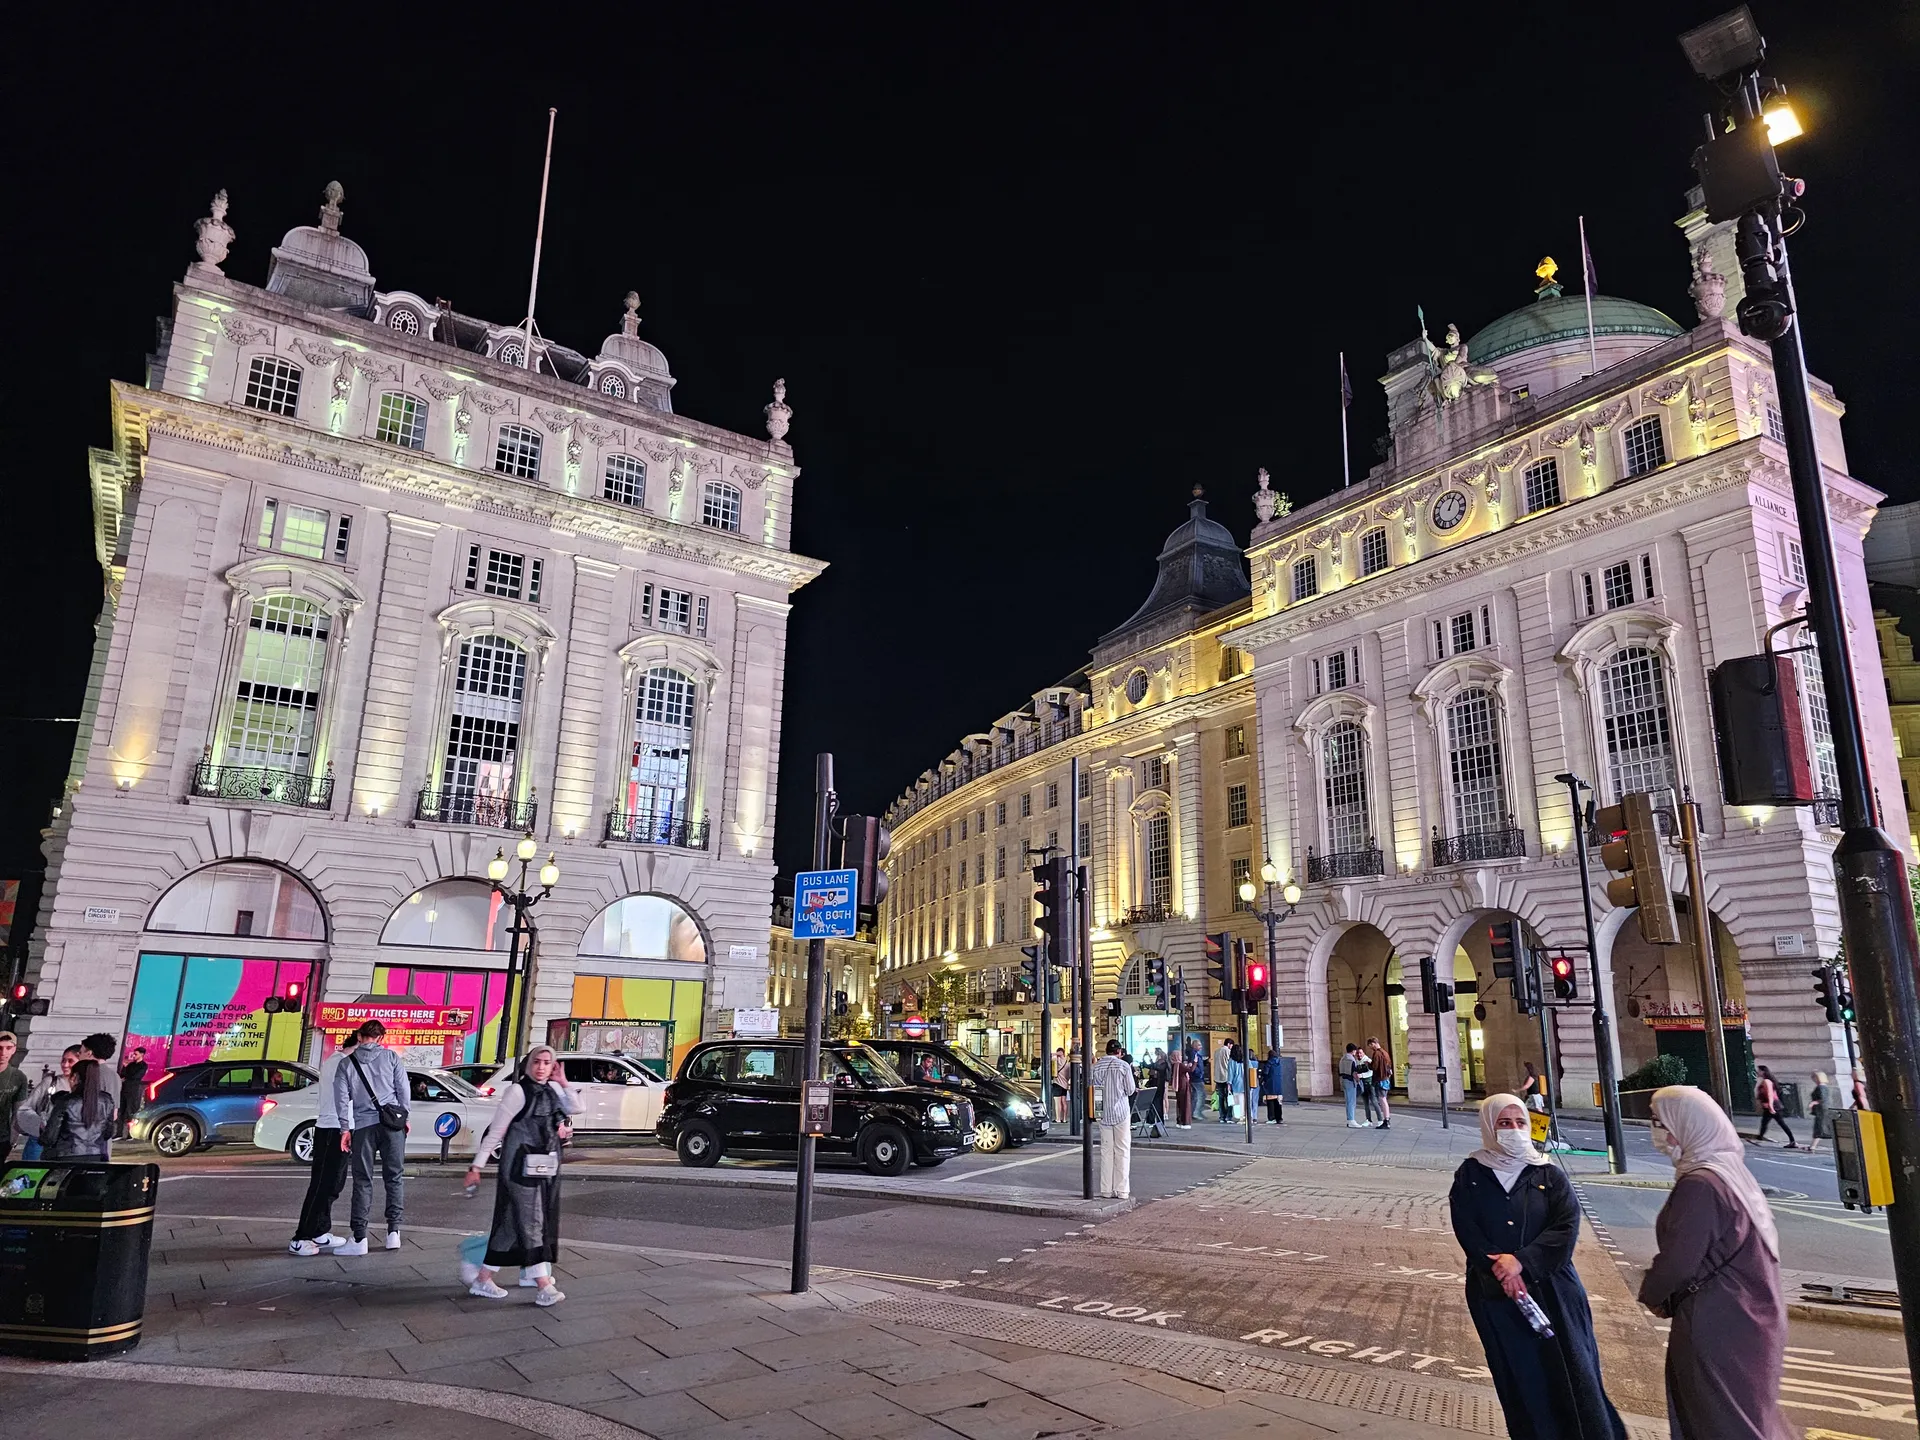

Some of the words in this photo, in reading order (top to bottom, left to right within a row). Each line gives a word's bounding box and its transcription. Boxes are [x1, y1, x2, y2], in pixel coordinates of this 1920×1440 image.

[1754, 495, 1788, 518] ALLIANCE
[803, 876, 822, 886] BUS
[825, 874, 850, 885] LANE
[1415, 872, 1463, 884] COUNTY
[797, 911, 824, 921] LOOK
[825, 910, 852, 920] BOTH
[810, 923, 837, 934] WAYS
[184, 1002, 220, 1011] FASTEN
[222, 1003, 247, 1012] YOUR
[183, 1011, 234, 1020] SEATBELTS
[235, 1013, 254, 1021] FOR
[347, 1008, 367, 1018] BUY
[369, 1009, 408, 1018] TICKETS
[409, 1010, 436, 1019] HERE
[189, 1021, 258, 1030] MIND-BLOWING
[248, 1031, 266, 1039] THE
[382, 1035, 412, 1045] KETS
[414, 1035, 445, 1045] HERE
[1036, 1296, 1183, 1325] LOOK
[1239, 1328, 1455, 1370] RIGHT
